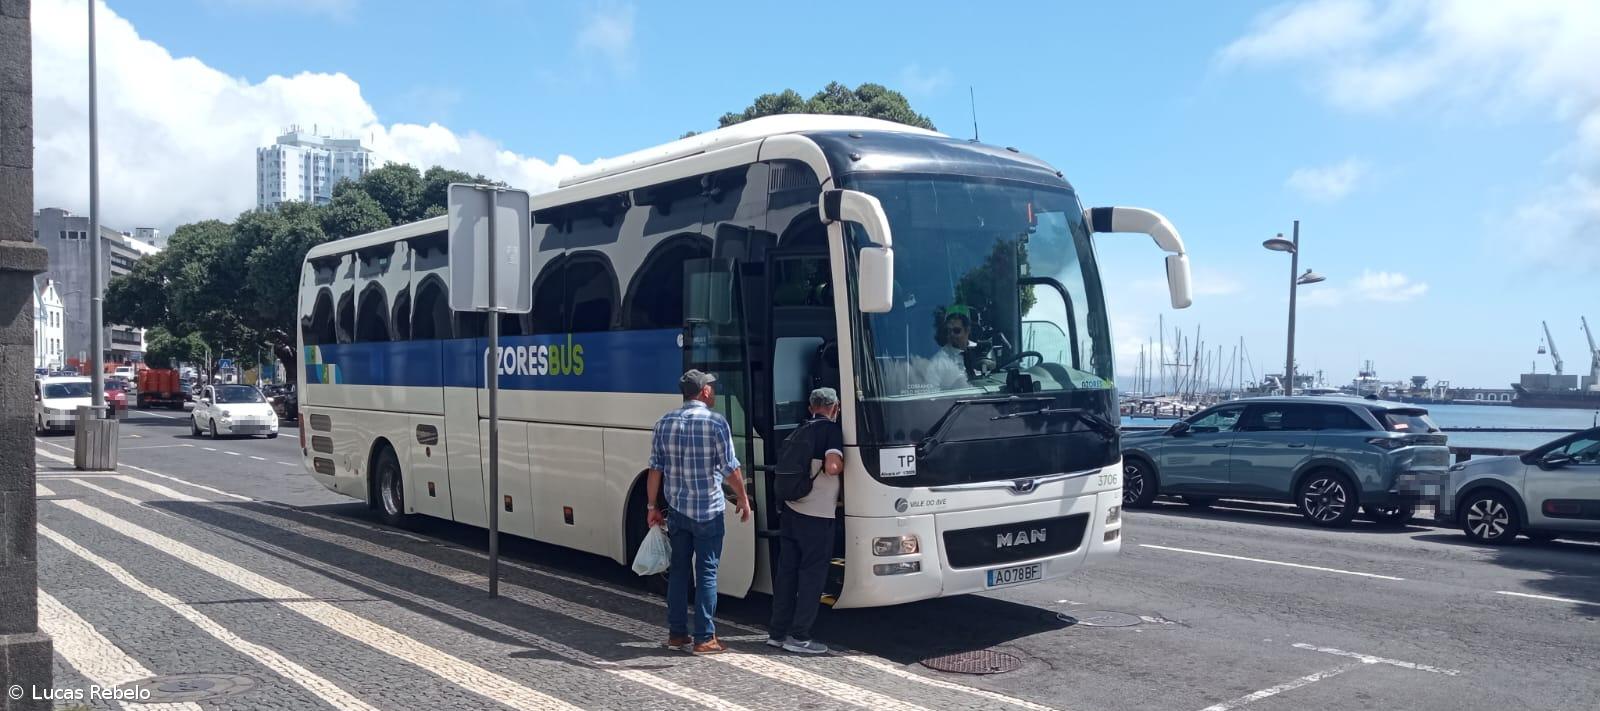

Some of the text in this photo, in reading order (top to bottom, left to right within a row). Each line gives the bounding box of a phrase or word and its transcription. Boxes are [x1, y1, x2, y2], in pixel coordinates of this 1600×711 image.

[897, 455, 915, 468] TP
[1098, 473, 1118, 487] 3706
[996, 528, 1047, 548] MAN
